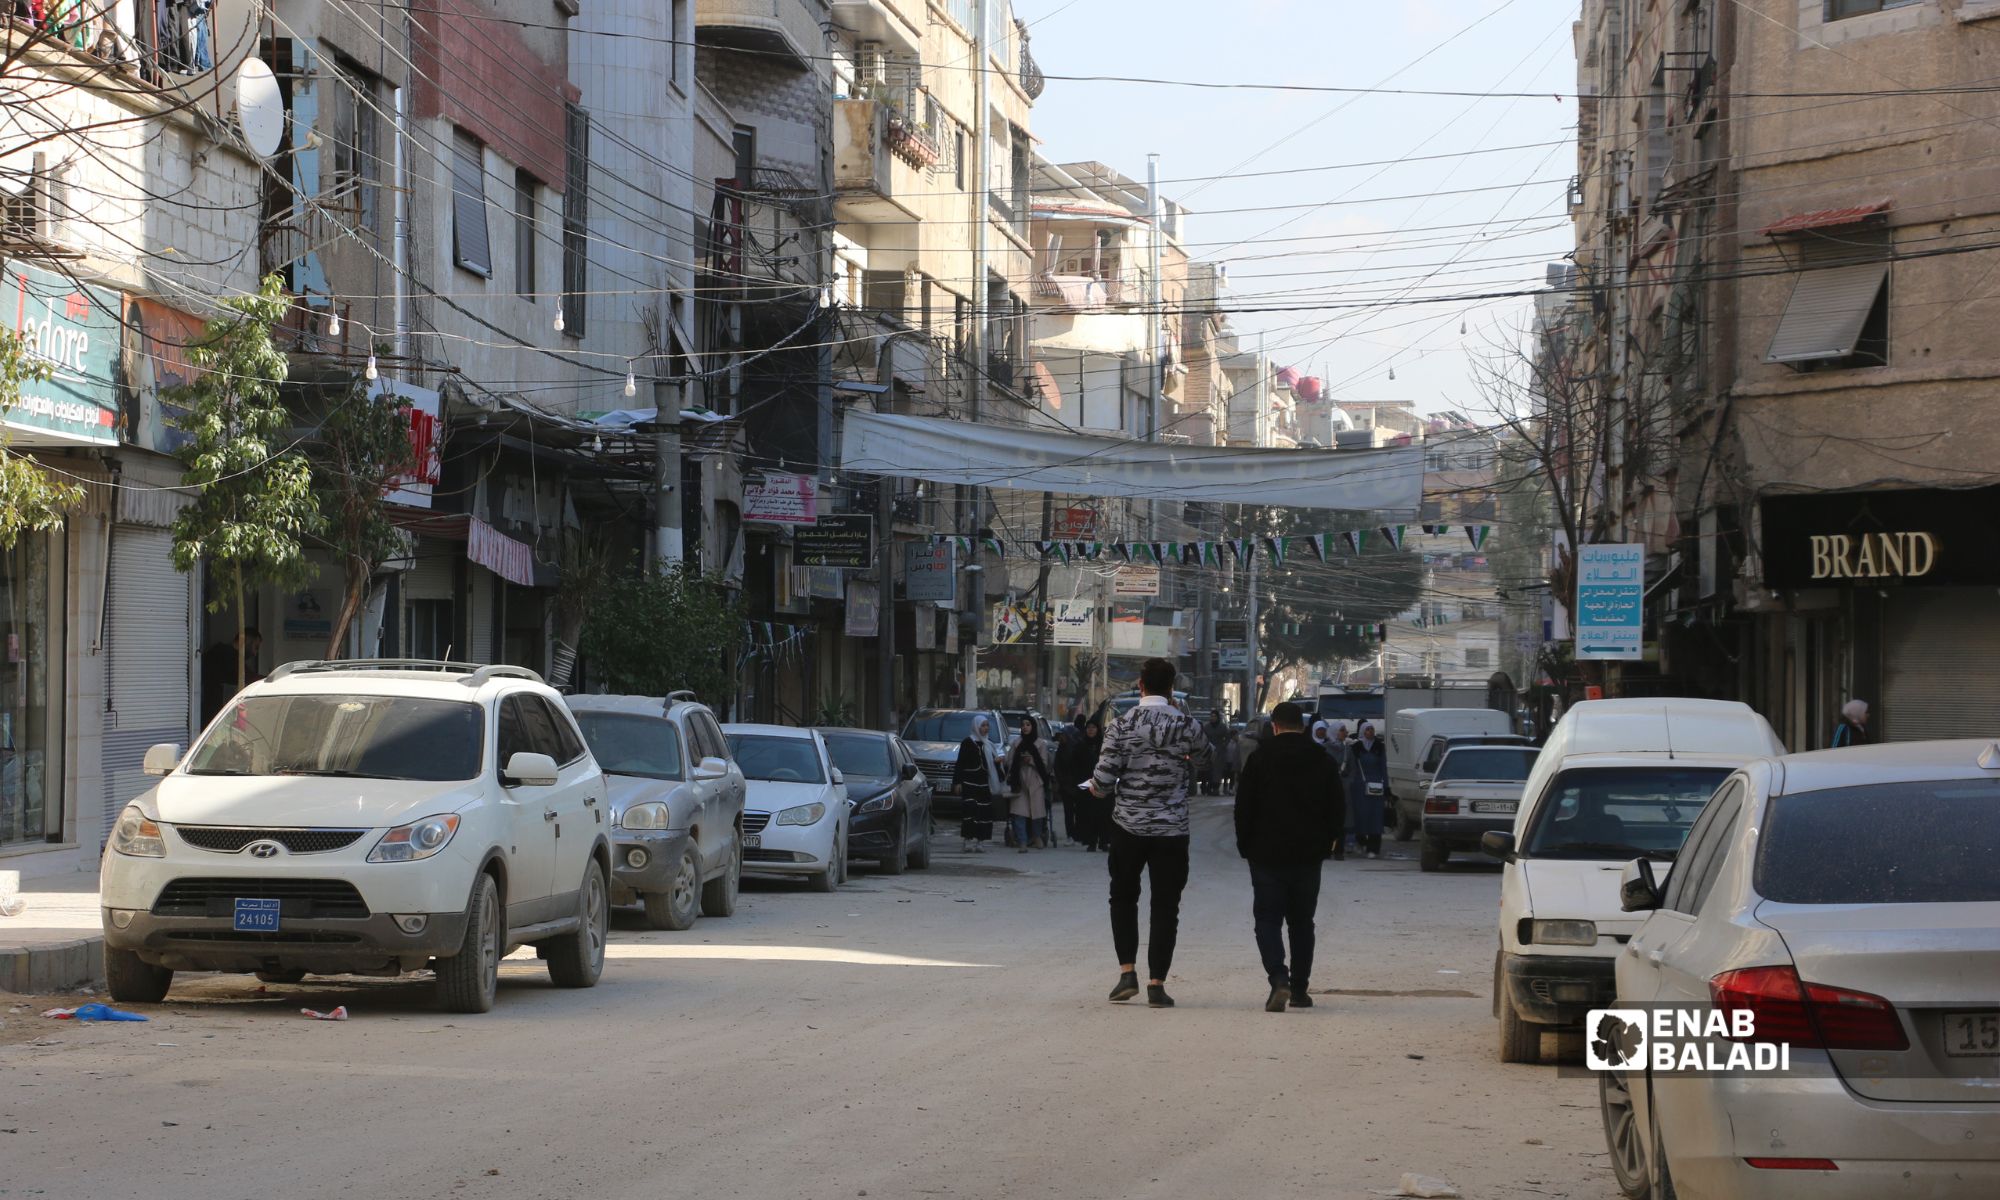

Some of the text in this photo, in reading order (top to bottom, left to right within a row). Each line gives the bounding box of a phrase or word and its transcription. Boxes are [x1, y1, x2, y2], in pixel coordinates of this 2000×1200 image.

[1582, 549, 1640, 564] ملبوسات
[1810, 531, 1935, 579] BRAND
[1586, 567, 1637, 581] العلاء
[239, 913, 274, 925] 24105
